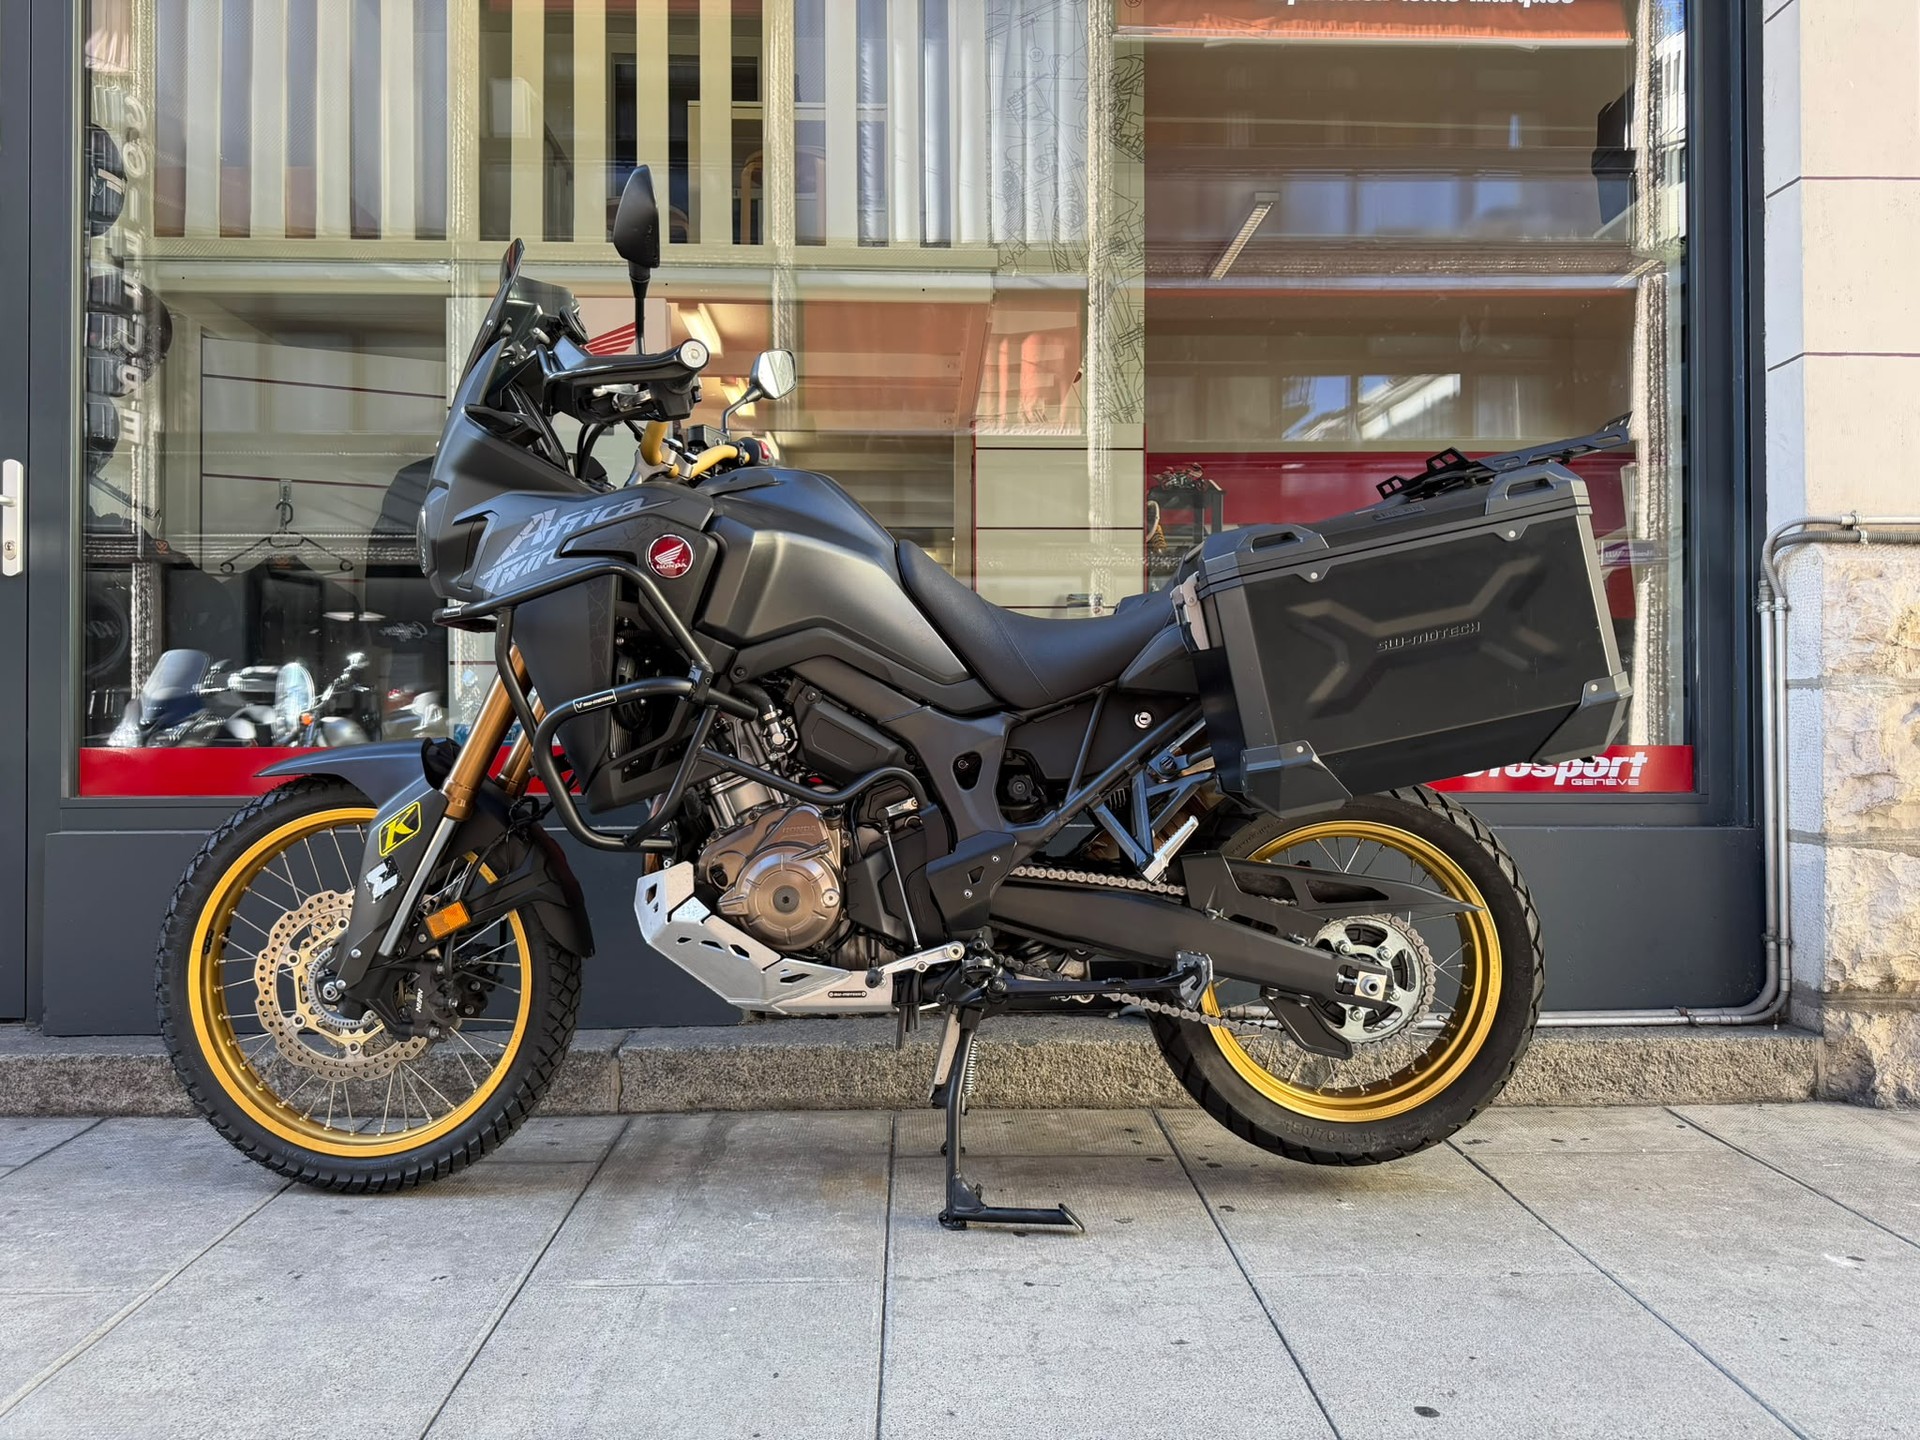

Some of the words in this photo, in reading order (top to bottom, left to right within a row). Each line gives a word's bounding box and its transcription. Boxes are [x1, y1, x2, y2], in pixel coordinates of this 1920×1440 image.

[500, 498, 670, 560] Africa
[480, 548, 564, 592] Twin
[656, 558, 687, 569] HONDA
[1463, 751, 1648, 785] osport
